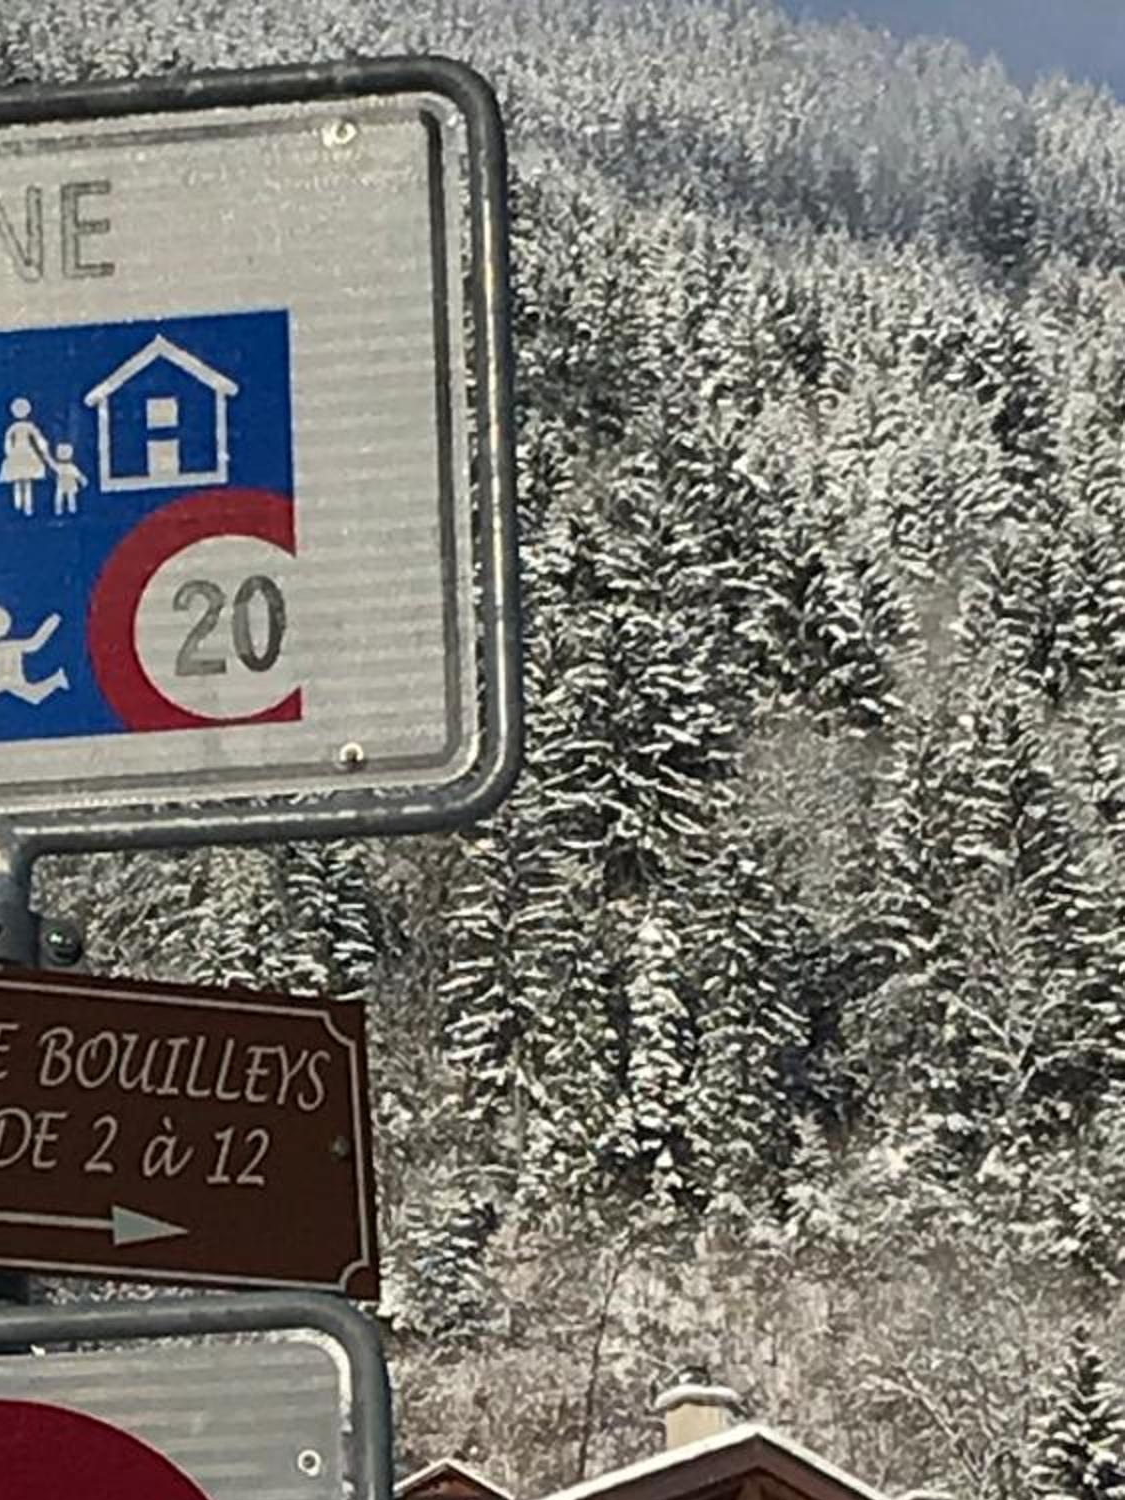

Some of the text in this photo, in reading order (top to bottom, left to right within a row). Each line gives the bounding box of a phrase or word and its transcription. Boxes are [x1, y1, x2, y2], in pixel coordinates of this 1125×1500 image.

[172, 574, 286, 678] 20
[38, 1027, 332, 1112] BOUILLEYS
[84, 1115, 118, 1174] 2
[141, 1116, 195, 1178] à
[205, 1128, 271, 1186] 12
